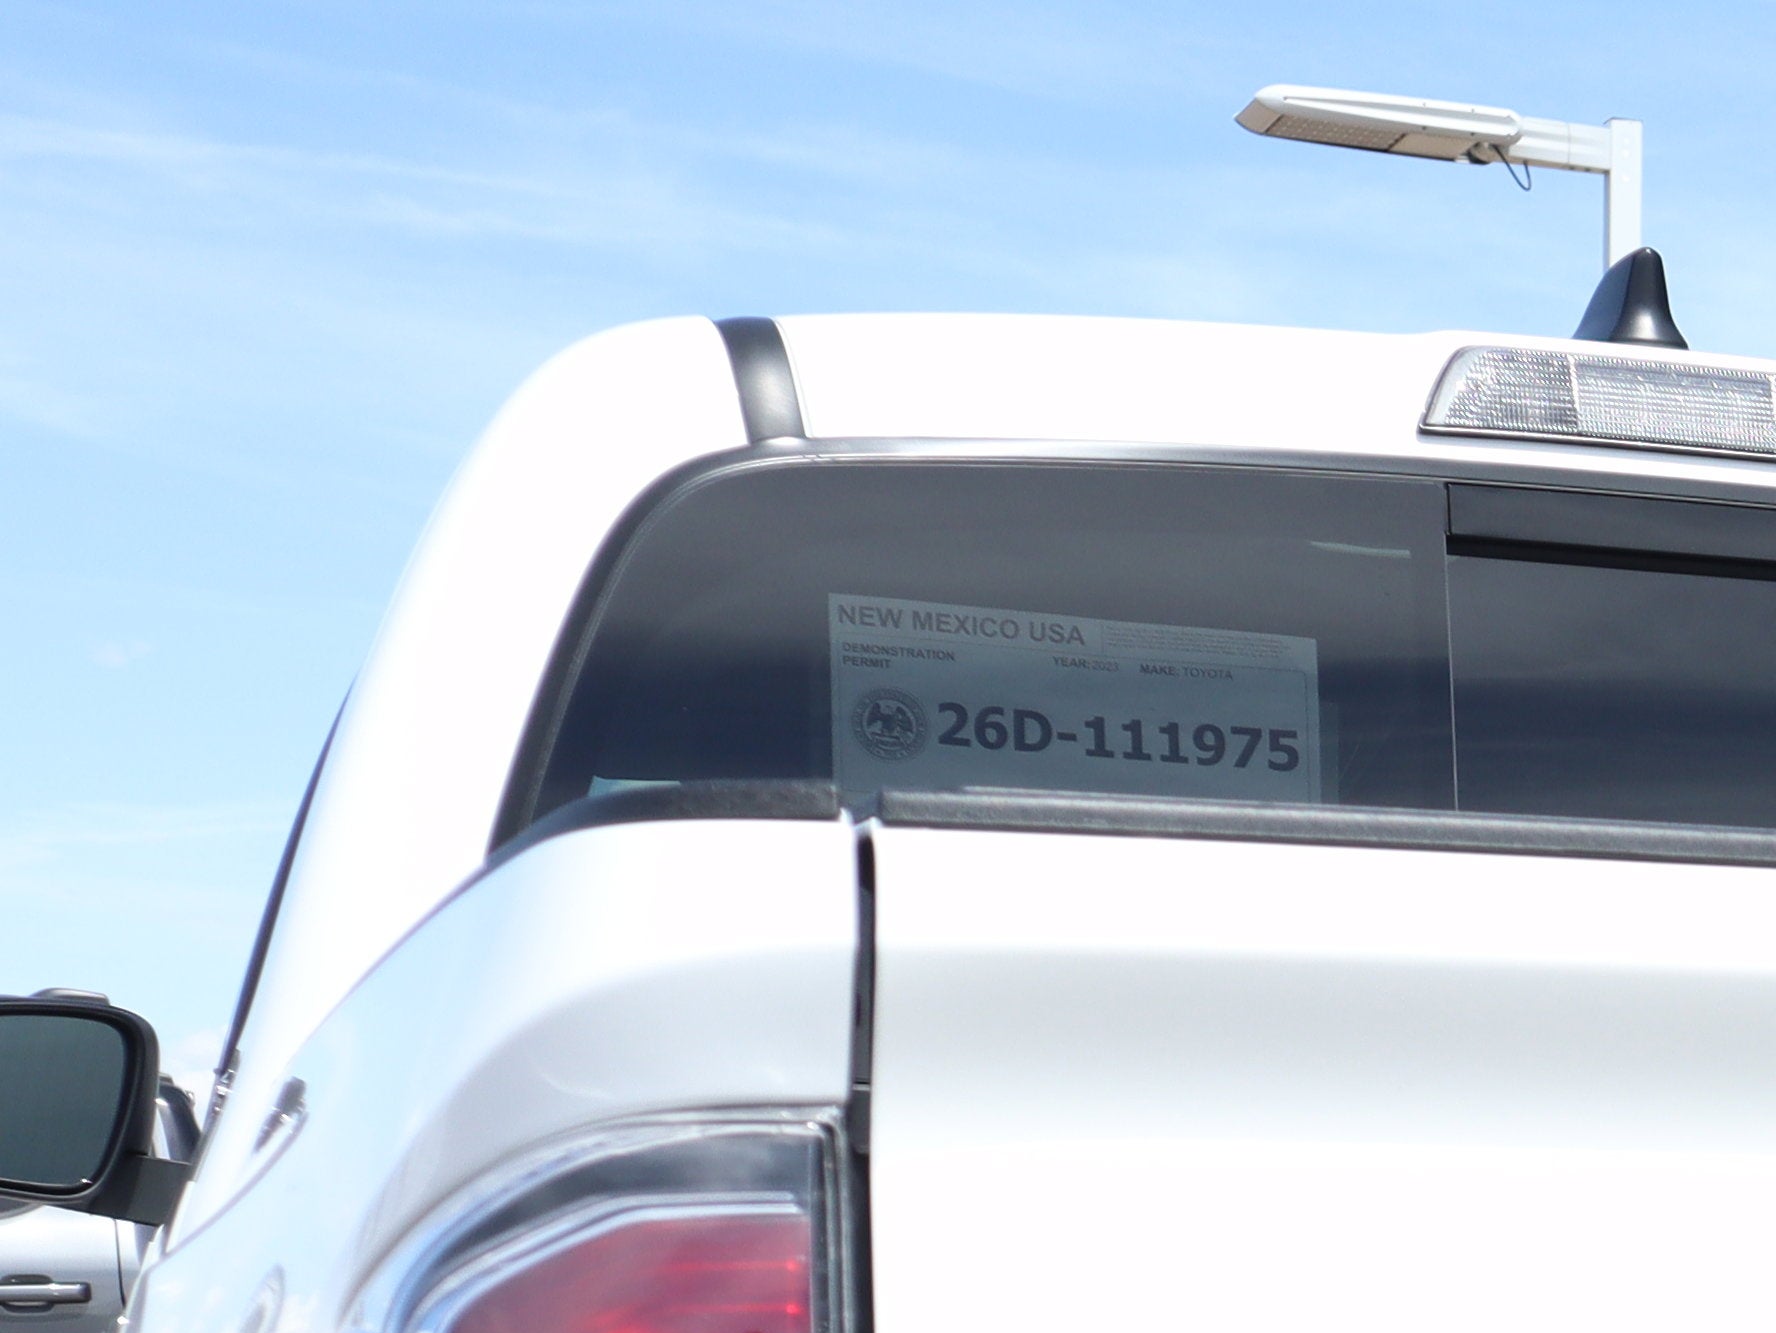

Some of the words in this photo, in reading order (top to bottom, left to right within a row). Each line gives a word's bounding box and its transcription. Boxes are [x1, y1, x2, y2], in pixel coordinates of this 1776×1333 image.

[837, 604, 903, 630] NEW
[912, 610, 1020, 639] MEXICO
[1029, 621, 1085, 645] USA
[842, 641, 955, 662] DEMONSTRATION
[842, 656, 891, 669] PERMIT
[1140, 663, 1180, 677] MAKE:
[1183, 666, 1233, 681] TOYOTA
[936, 702, 1300, 772] 26D-111975
